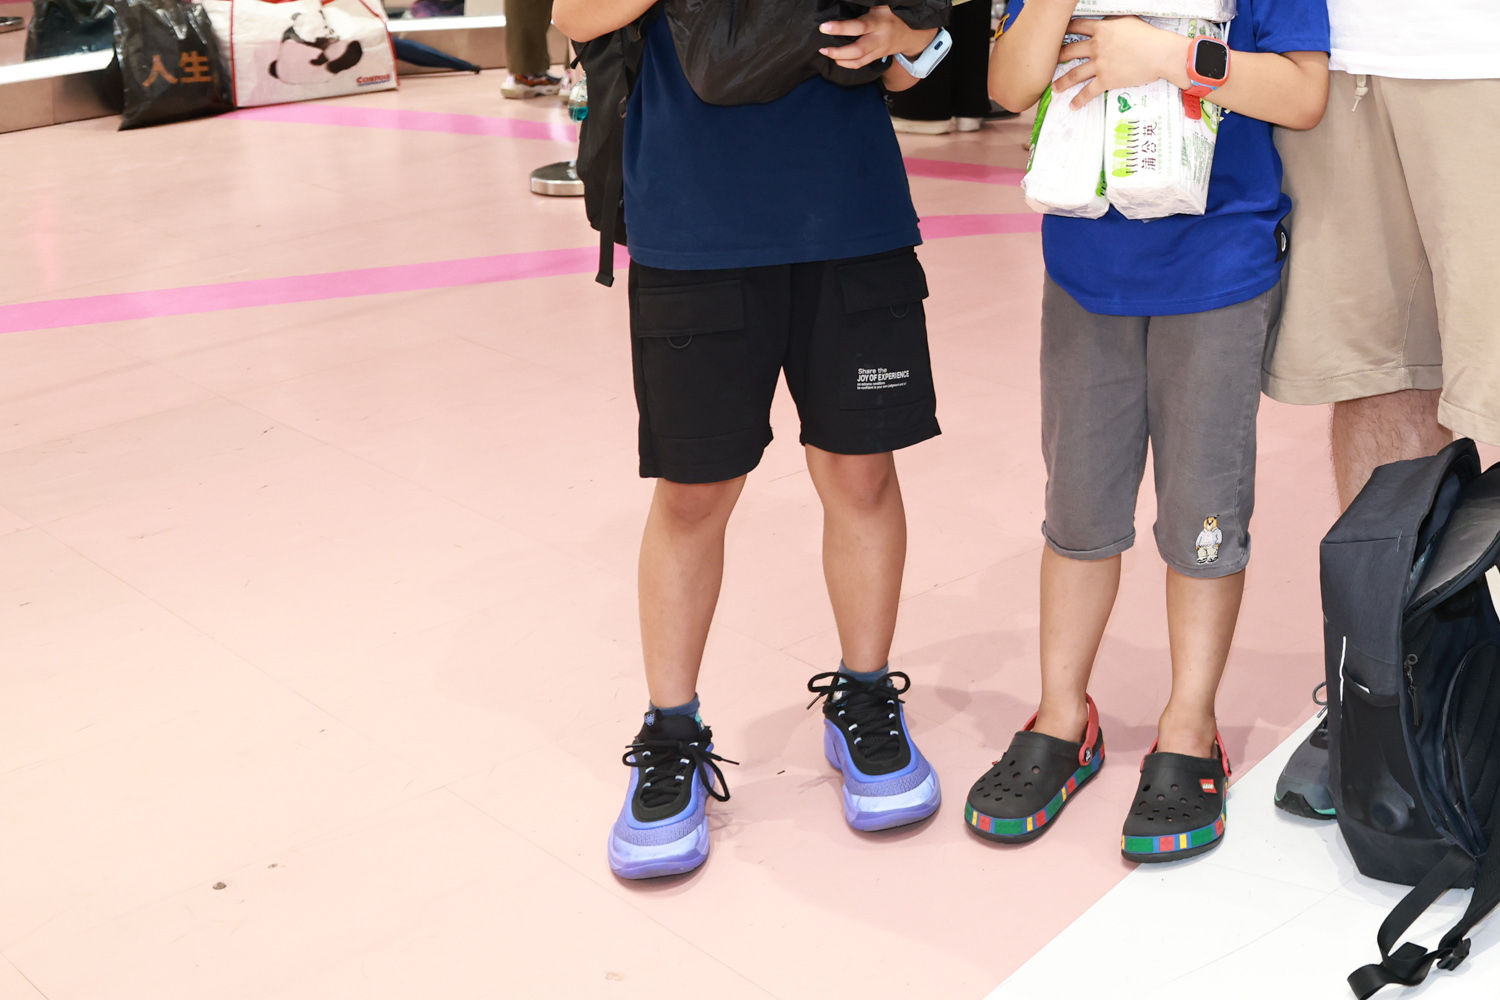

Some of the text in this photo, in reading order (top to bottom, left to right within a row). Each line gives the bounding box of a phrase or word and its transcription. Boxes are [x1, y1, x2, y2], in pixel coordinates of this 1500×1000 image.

[142, 51, 212, 87] 人生
[1141, 121, 1158, 172] 蒲公英
[857, 374, 869, 382] JOY
[877, 370, 910, 381] EXPERIENCE
